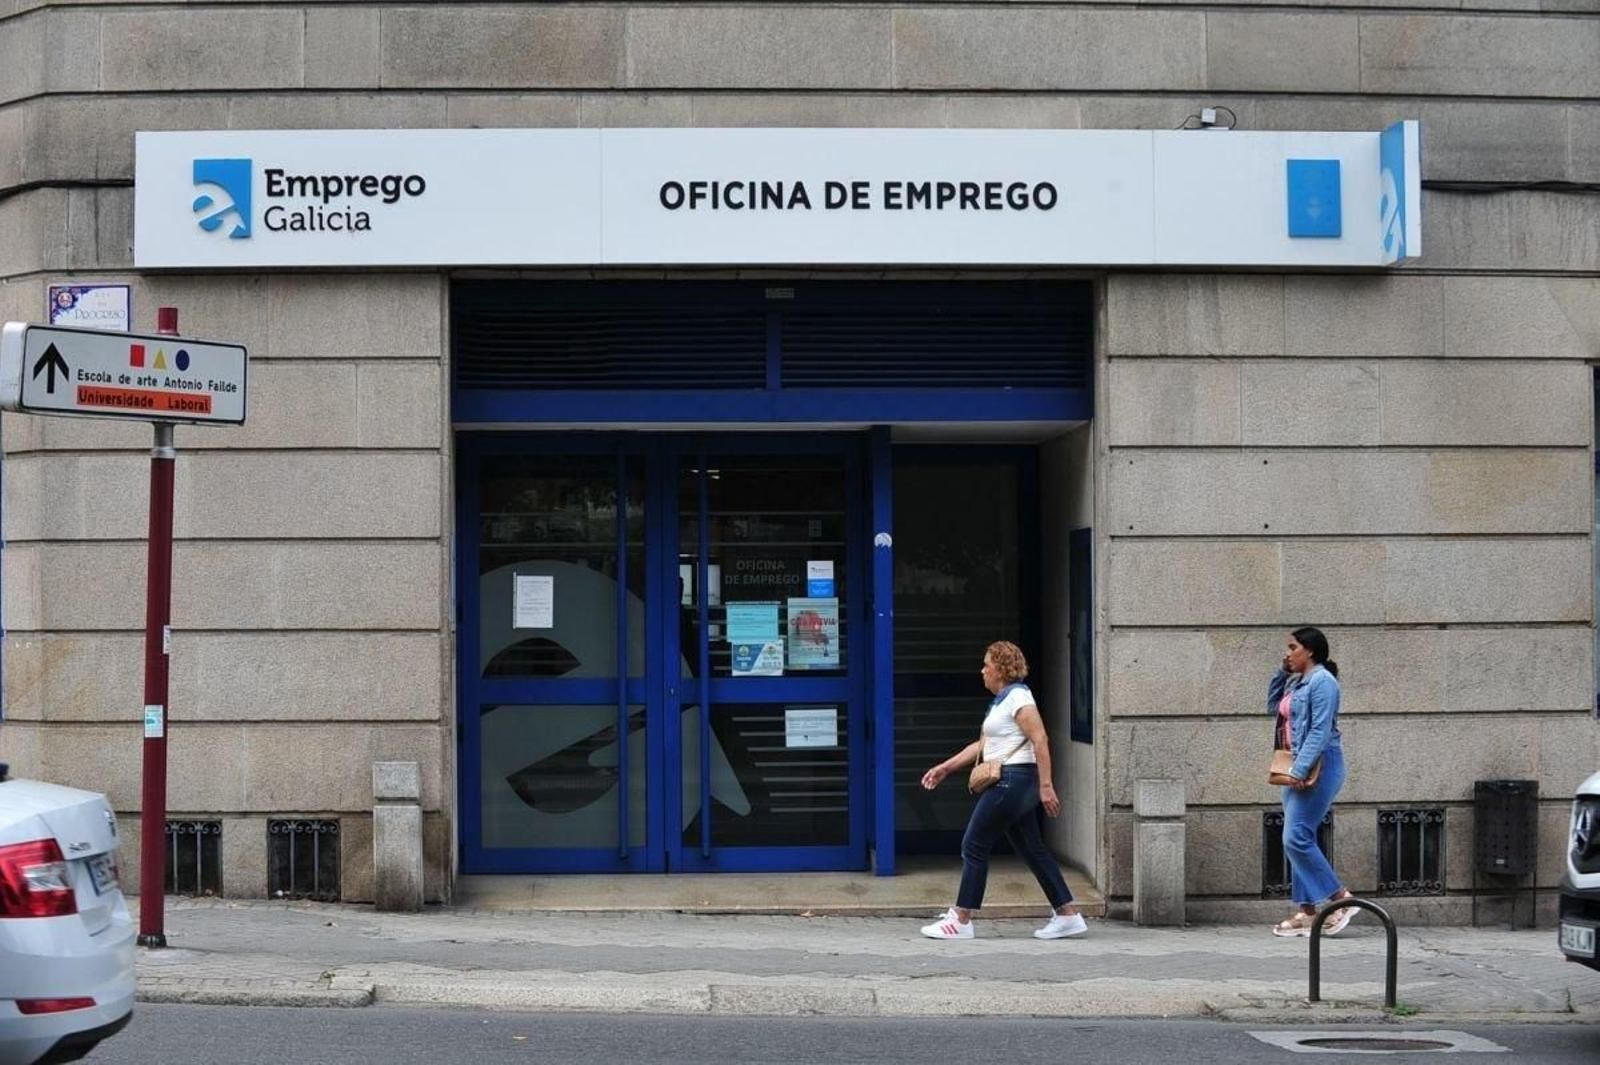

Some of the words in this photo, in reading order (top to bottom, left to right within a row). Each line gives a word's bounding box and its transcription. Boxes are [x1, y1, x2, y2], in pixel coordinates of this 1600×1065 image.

[264, 168, 426, 204] Emprego
[659, 181, 812, 210] OFICINA
[824, 181, 870, 210] DE
[884, 181, 1058, 211] EMPREGO
[264, 205, 372, 232] Galicia
[77, 368, 113, 384] Escola
[118, 373, 131, 385] de
[137, 375, 158, 387] arte
[164, 376, 202, 391] Antonio
[208, 379, 238, 393] Failde
[78, 389, 154, 408] Universidade
[168, 397, 209, 412] Laboral
[735, 560, 786, 571] OFICINA
[725, 575, 740, 585] DE
[743, 574, 800, 585] EMPREGO
